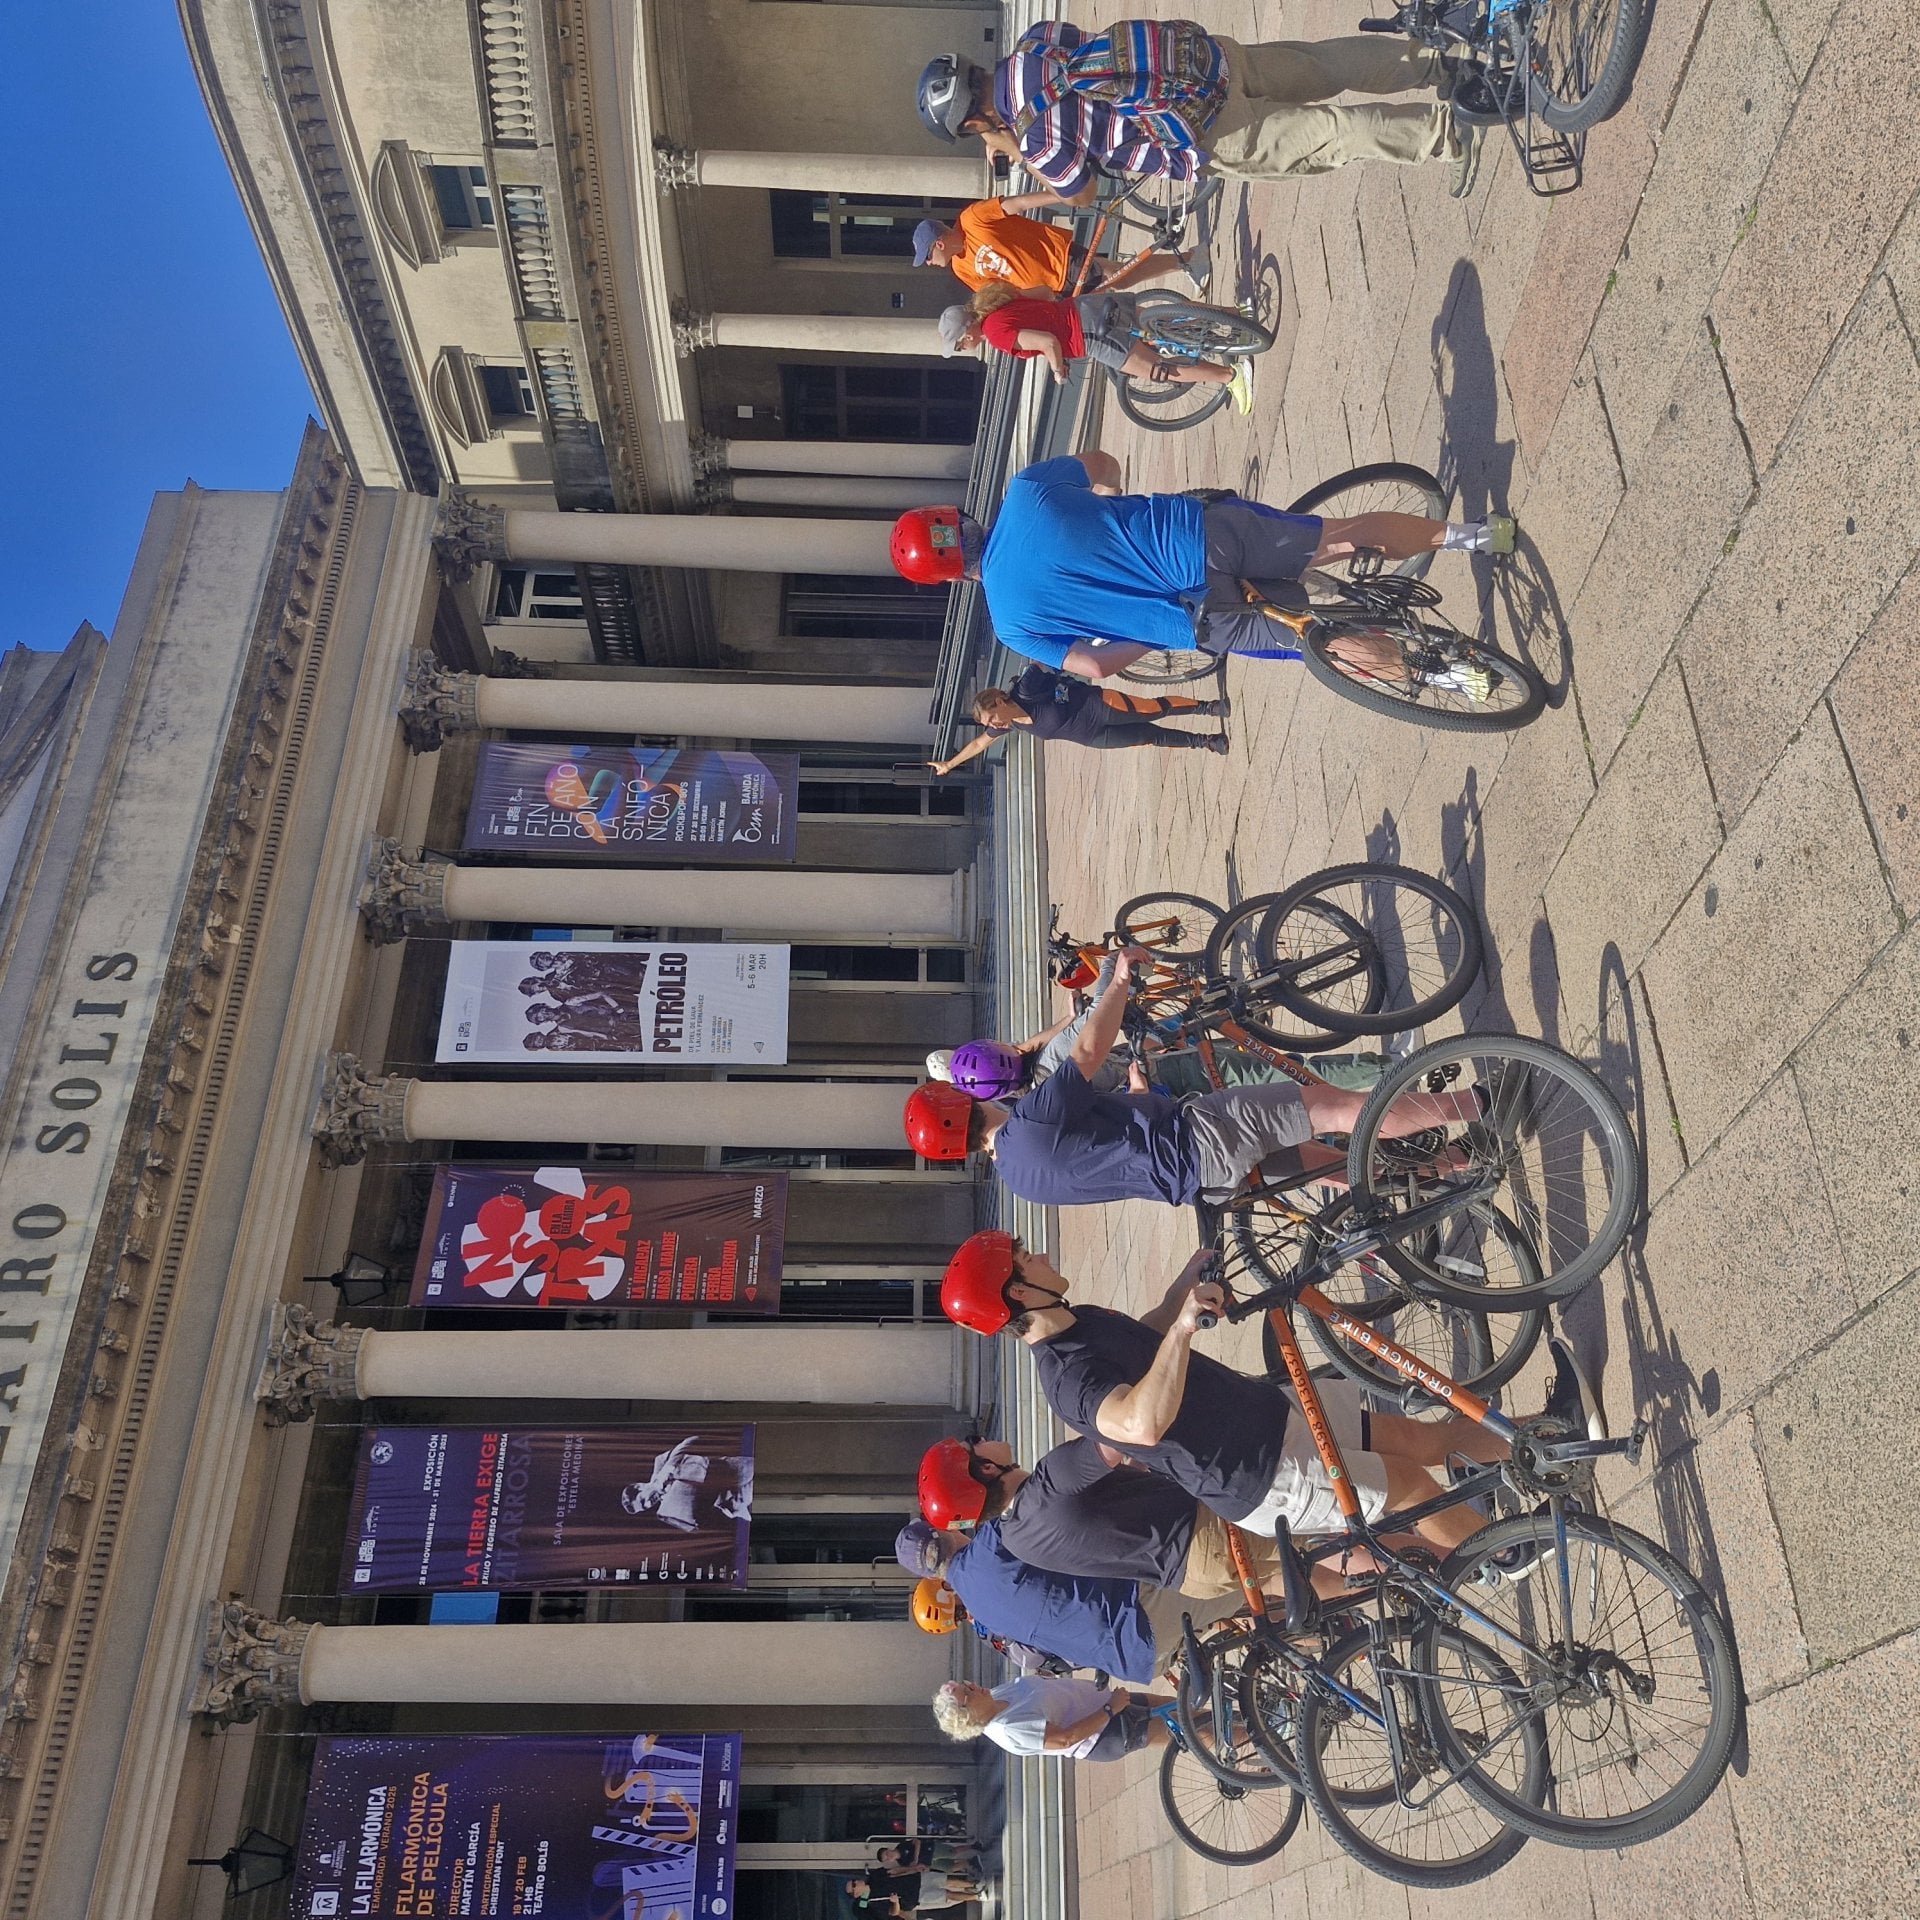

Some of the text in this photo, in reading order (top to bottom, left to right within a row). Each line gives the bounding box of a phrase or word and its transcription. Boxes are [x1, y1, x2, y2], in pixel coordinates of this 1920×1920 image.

[549, 764, 579, 837] DE AÑO
[741, 774, 752, 804] BANDA
[752, 774, 760, 804] SINFÓNICA
[524, 803, 550, 836] FIN
[574, 796, 599, 838] CON
[598, 816, 621, 839] LA
[646, 792, 672, 841] NICA
[674, 800, 687, 842] ROCK&POP
[748, 953, 757, 989] 5-6 MAR
[758, 953, 768, 970] 20H
[650, 952, 688, 1053] PETRÓLEO
[36, 952, 138, 1154] SOLIS
[1243, 1037, 1277, 1062] BIKE
[449, 1180, 458, 1202] RENNER
[753, 1185, 764, 1218] MARZO
[550, 1212, 562, 1234] EN LA
[561, 1199, 576, 1234] DELMIRA
[630, 1239, 651, 1299] LA INCAPAZ
[656, 1231, 677, 1300] MASA MADRE
[680, 1256, 698, 1300] PIONERA
[706, 1267, 722, 1300] PERRA
[720, 1240, 738, 1301] CIMARRONA
[1329, 1308, 1454, 1398] ORANGE BIKE
[1280, 1342, 1334, 1463] +598 91366377
[423, 1434, 440, 1491] EXPOSICIÓN
[436, 1451, 446, 1476] MARZO
[496, 1432, 509, 1470] ZITARROSA
[432, 1489, 440, 1497] 31
[434, 1478, 442, 1487] DE
[492, 1471, 504, 1505] ALFREDO
[552, 1432, 574, 1546] SALA DE EXPOSICIONES
[428, 1504, 438, 1521] 2024
[462, 1432, 498, 1586] LA TIERRA EXIGE
[490, 1506, 499, 1516] DE
[494, 1434, 533, 1580] ZITARROSA
[422, 1522, 435, 1564] NOVIEMBRE
[486, 1517, 498, 1552] REGRESO
[420, 1565, 428, 1575] DE
[481, 1560, 492, 1585] EXILIO
[351, 1785, 388, 1914] LA FILARMÓNICA
[371, 1785, 398, 1914] TEMPORADA VERANO 2025
[395, 1772, 430, 1915] FILARMÓNICA
[417, 1782, 448, 1915] DE PELÍCULA
[481, 1802, 500, 1915] PARTICIPACIÓN ESPECIAL
[449, 1858, 464, 1915] DIRECTOR
[460, 1821, 481, 1915] MARTÍN GARCÍA
[490, 1840, 504, 1915] CHRISTIAN FONT
[513, 1856, 527, 1915] 19 Y 20 FEB
[533, 1840, 549, 1915] TEATRO SOLÍS
[524, 1886, 534, 1915] 21 HS
